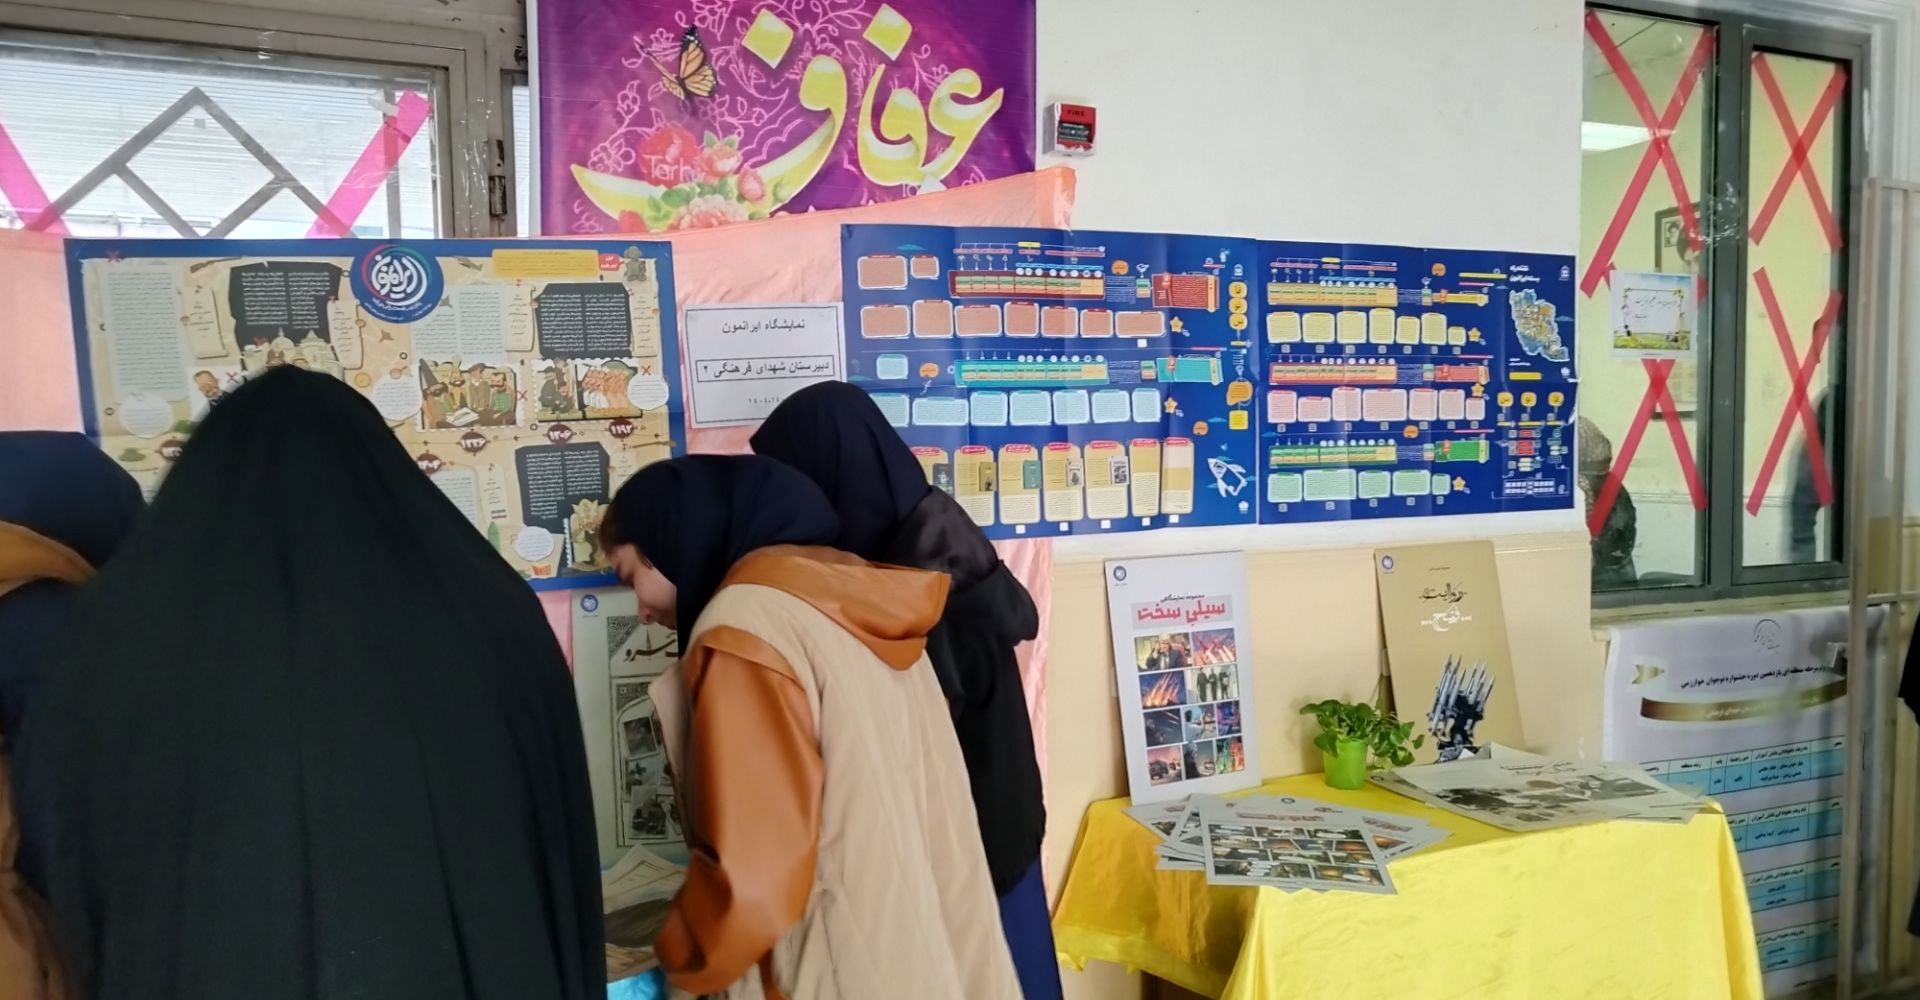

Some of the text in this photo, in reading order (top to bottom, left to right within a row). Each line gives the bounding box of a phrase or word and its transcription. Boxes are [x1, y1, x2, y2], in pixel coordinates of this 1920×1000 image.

[570, 4, 1004, 222] عفاف
[721, 318, 806, 334] نمایشگاه ایرانمون
[713, 361, 753, 378] فرهنگی
[755, 361, 787, 375] شهدای
[788, 361, 830, 374] دبیرستان
[1137, 602, 1182, 622] سخت
